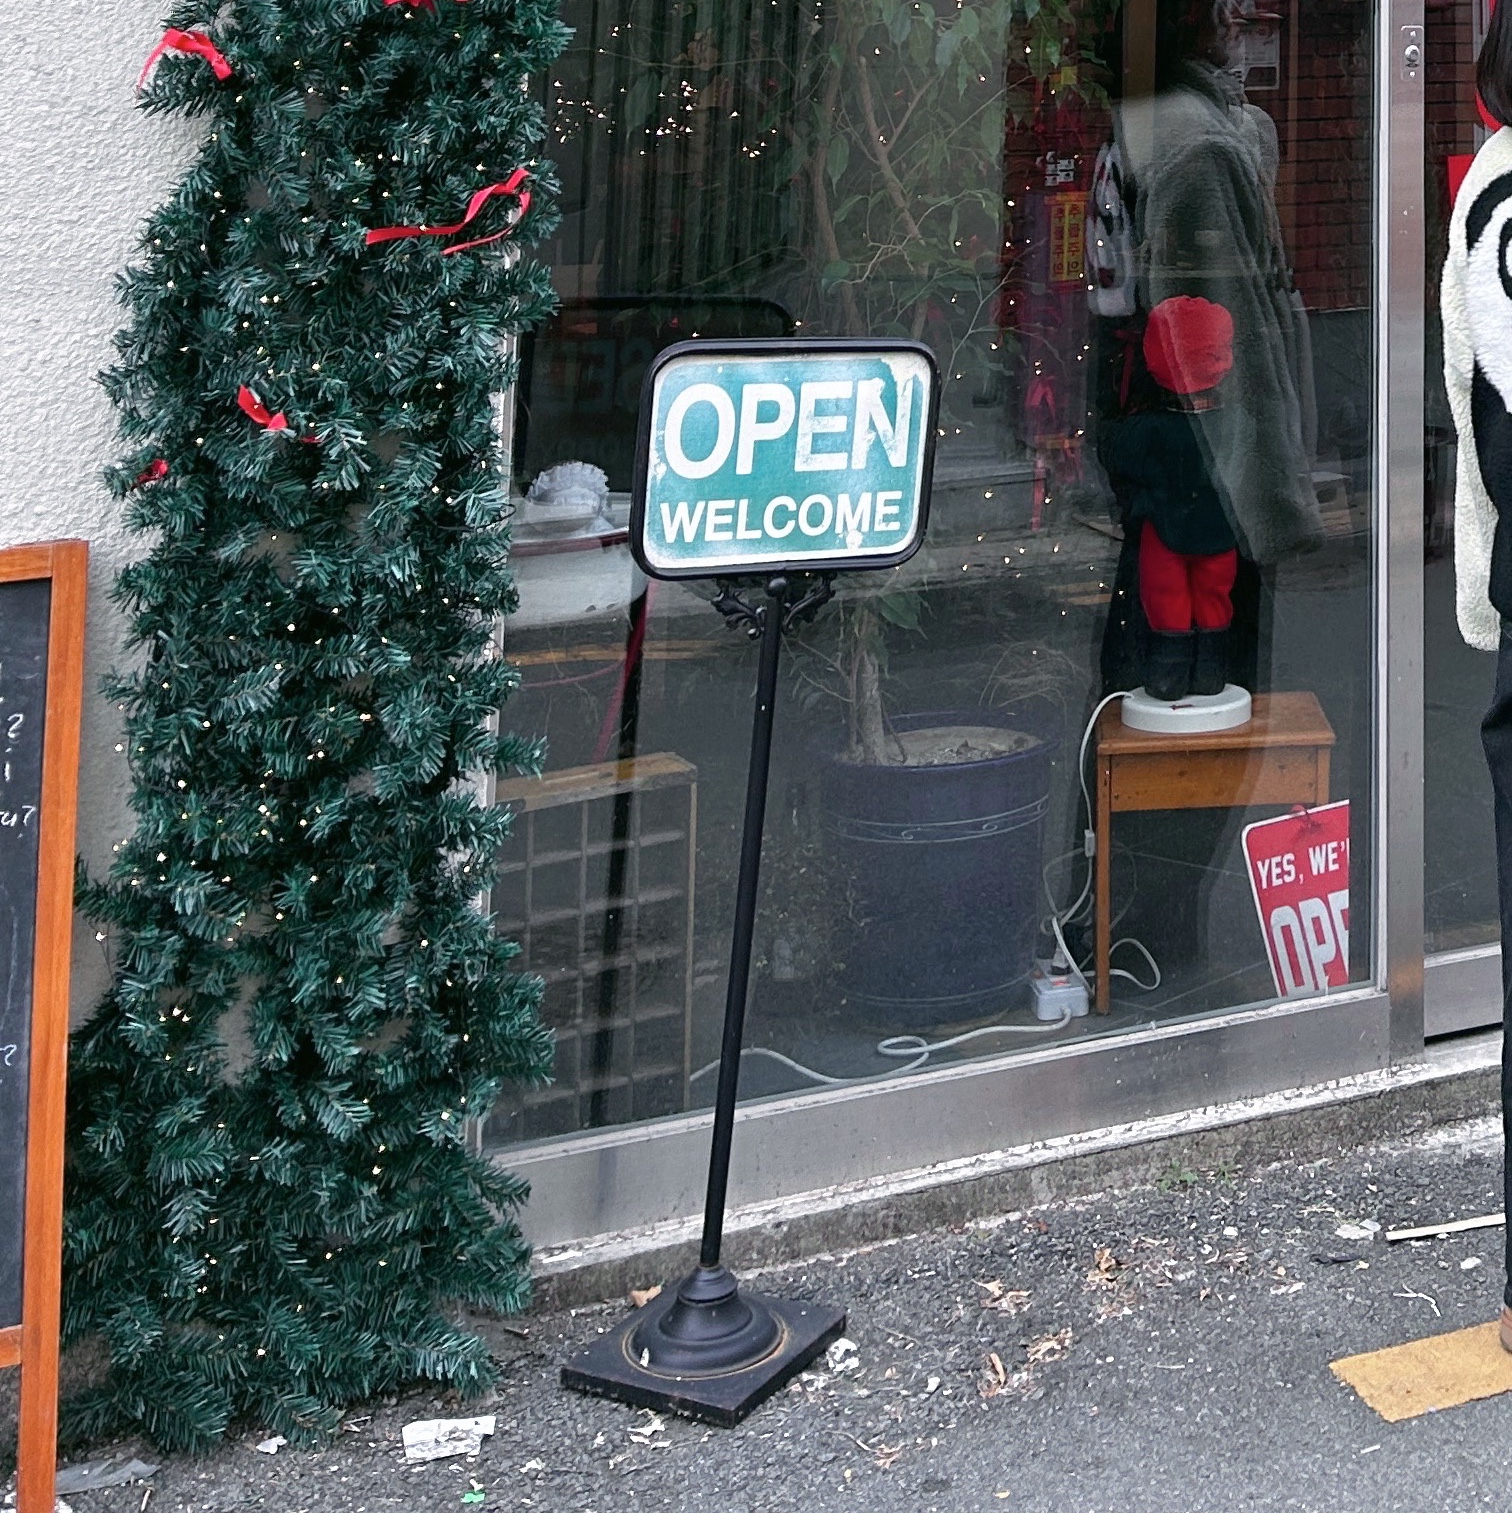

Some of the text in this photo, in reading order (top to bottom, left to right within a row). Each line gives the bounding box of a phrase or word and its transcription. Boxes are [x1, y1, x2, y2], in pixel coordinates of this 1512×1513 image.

[664, 375, 913, 480] OPEN
[660, 491, 902, 543] WELCOME
[1256, 837, 1350, 890] YES, WE'
